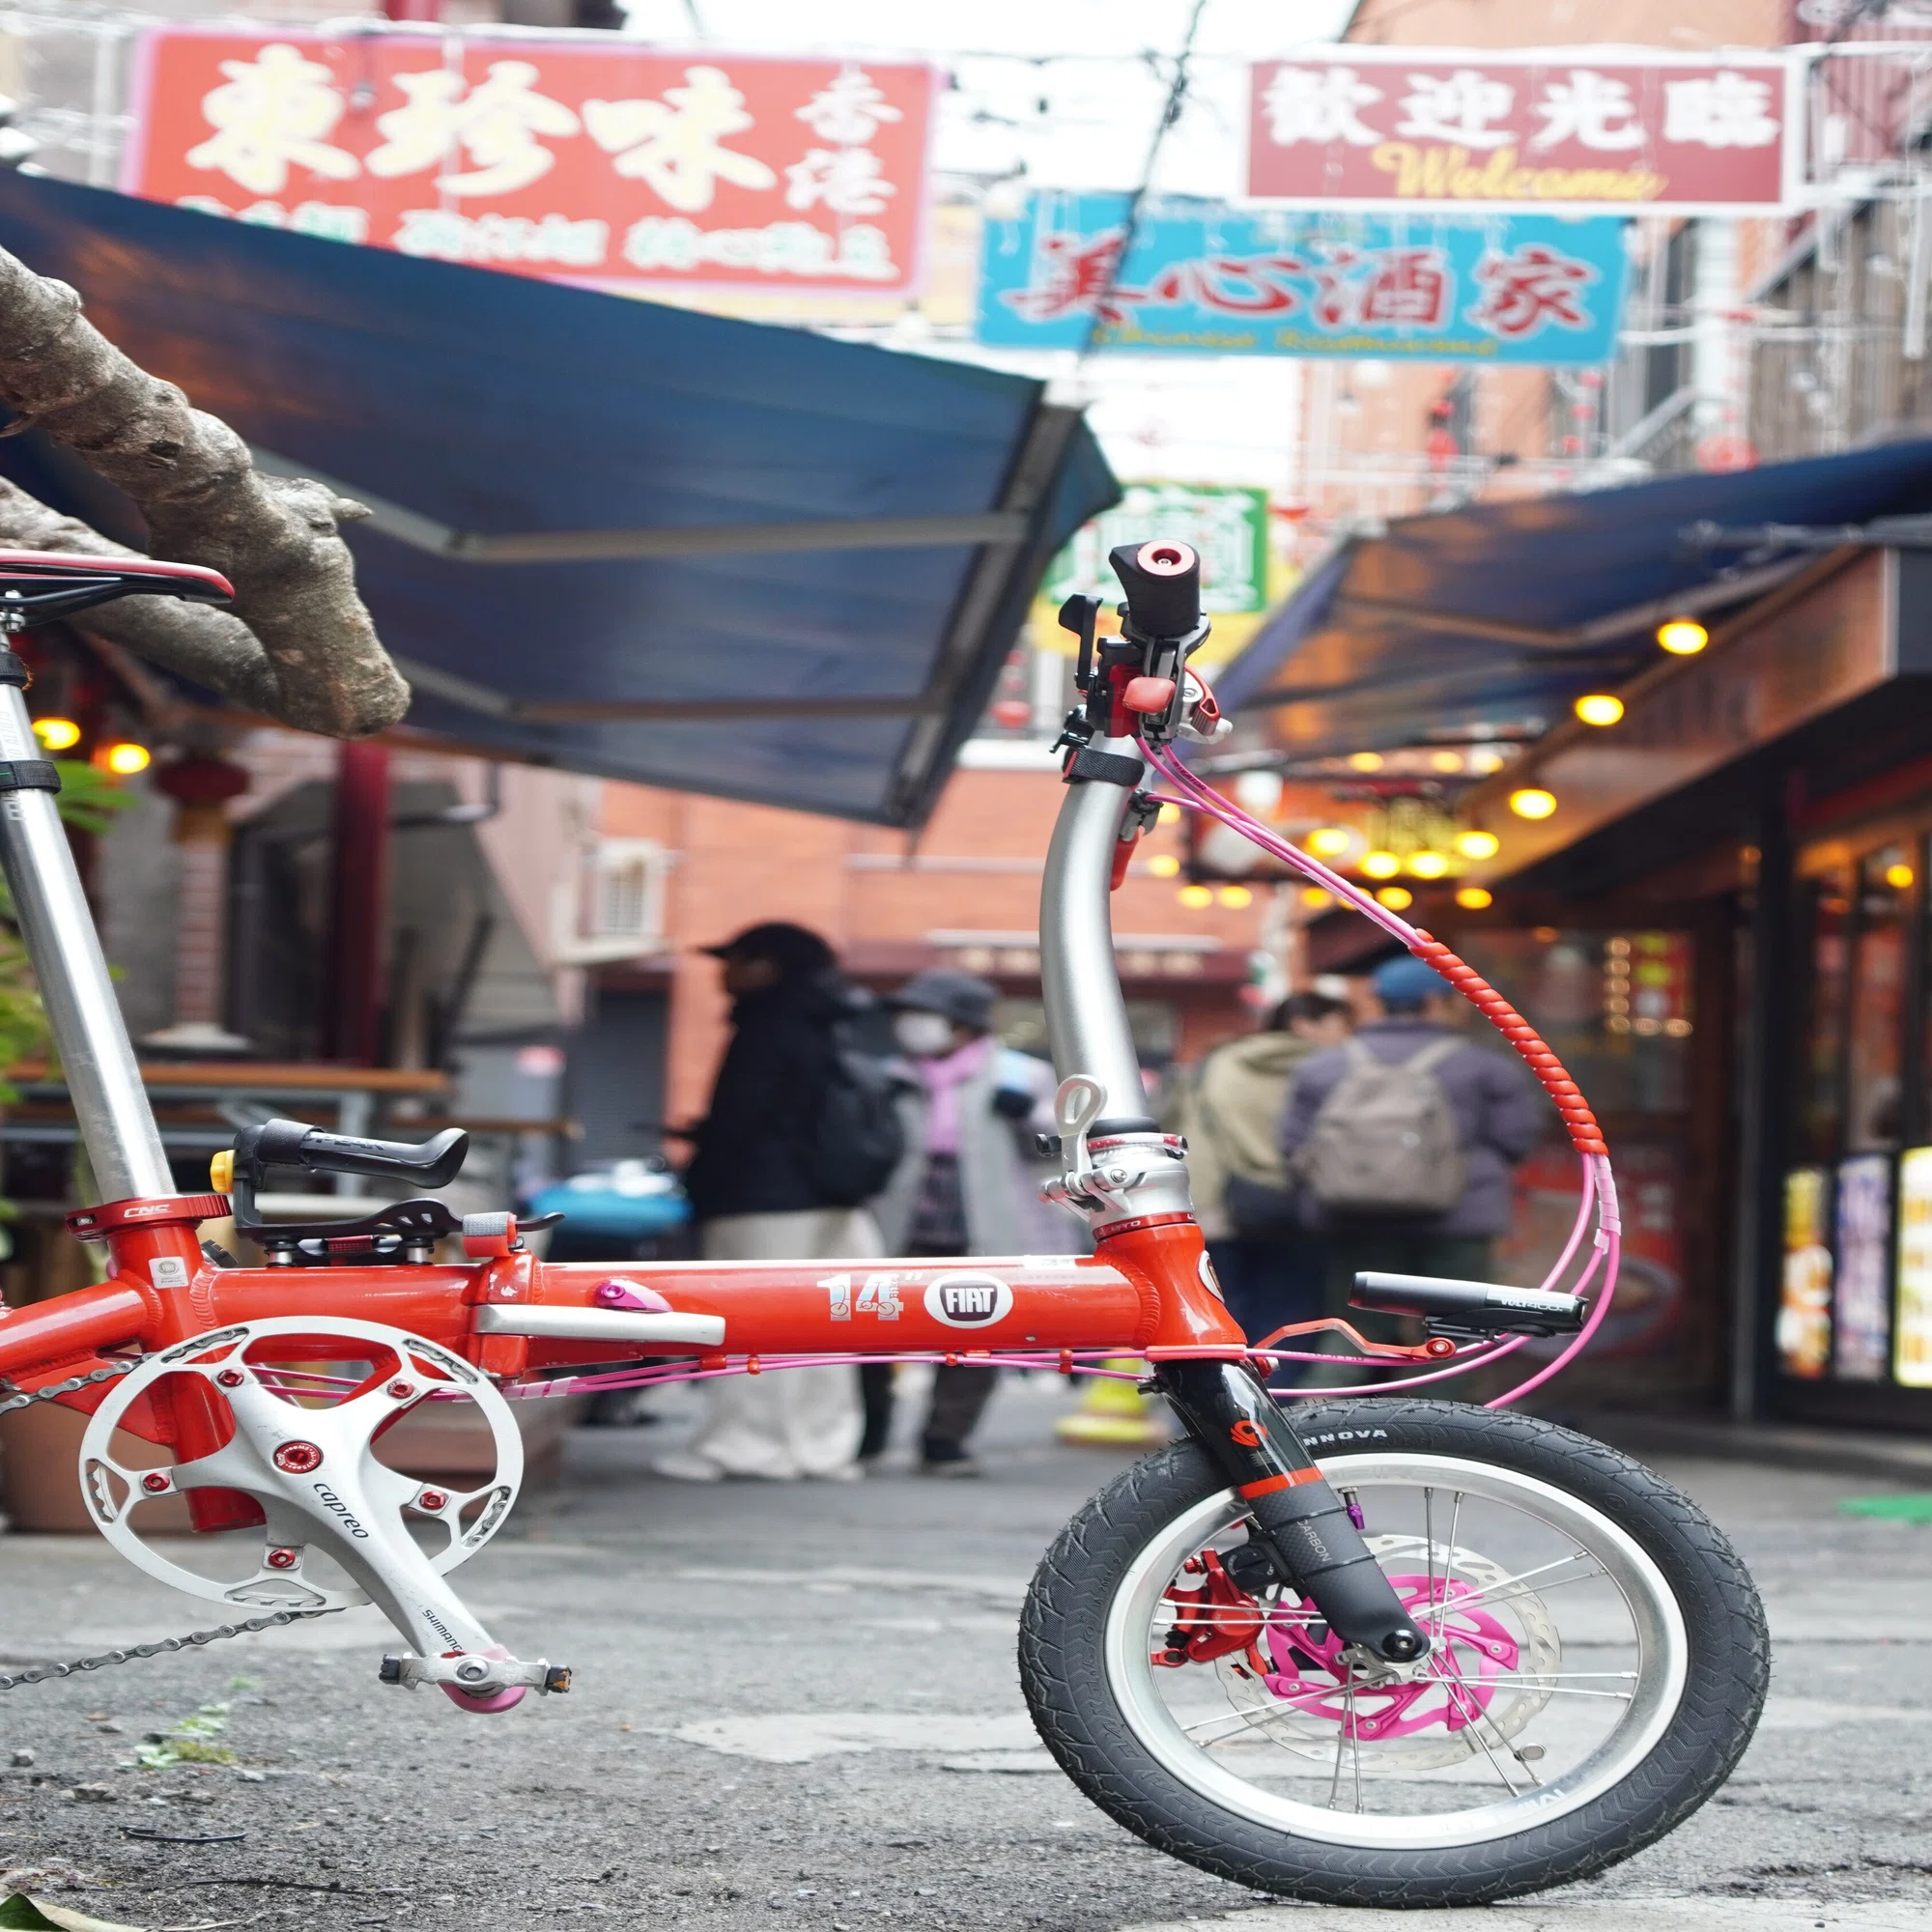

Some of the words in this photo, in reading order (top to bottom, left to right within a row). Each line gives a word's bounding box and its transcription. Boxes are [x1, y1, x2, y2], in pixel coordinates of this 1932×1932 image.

[945, 1288, 995, 1314] FIAT
[1302, 1429, 1388, 1447] NNOVA
[313, 1482, 370, 1539] capreo
